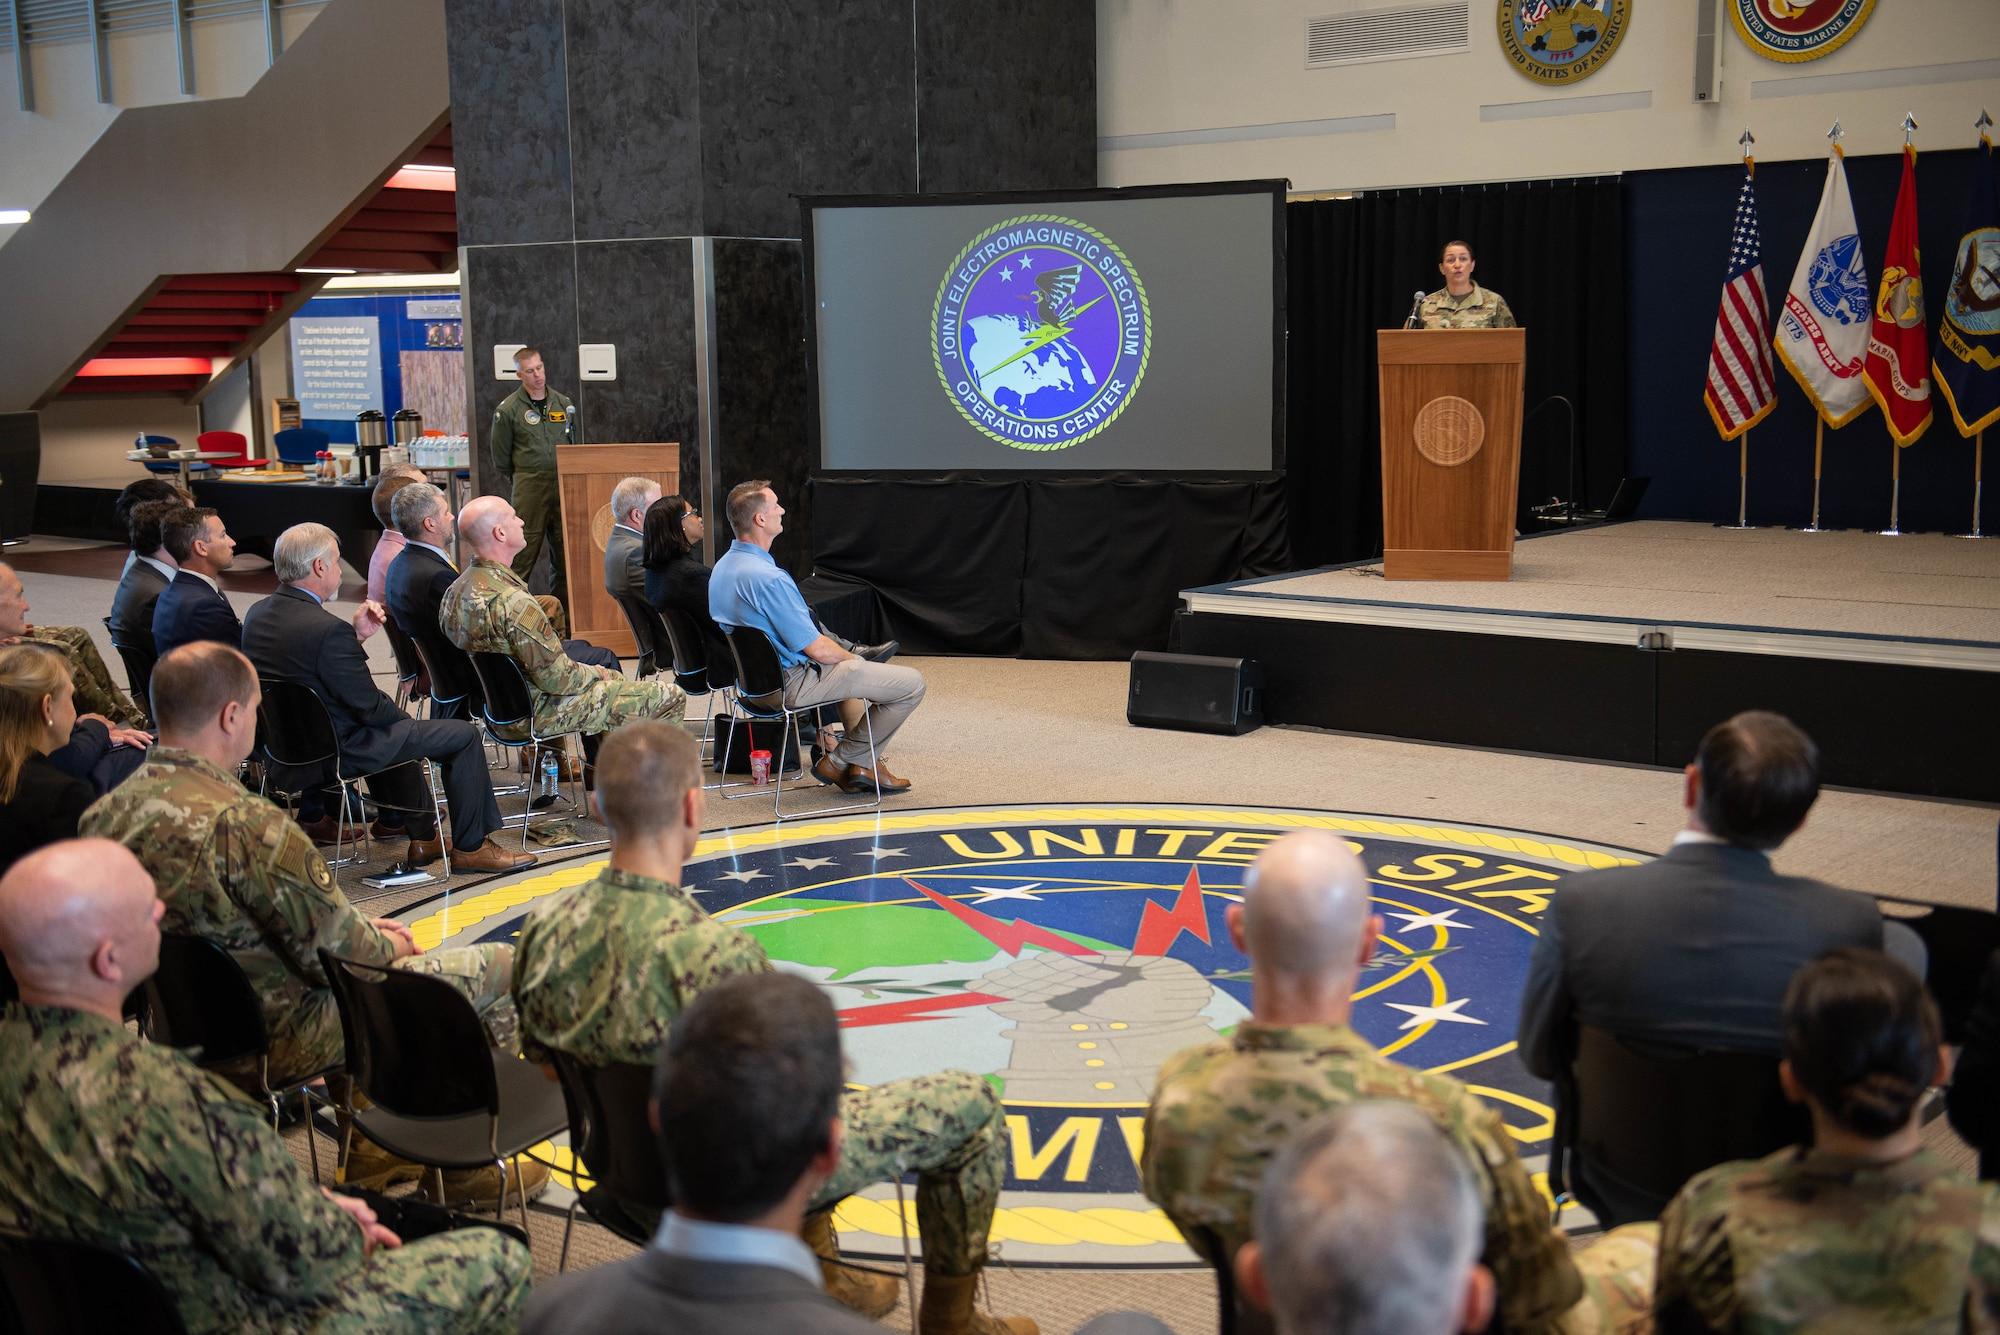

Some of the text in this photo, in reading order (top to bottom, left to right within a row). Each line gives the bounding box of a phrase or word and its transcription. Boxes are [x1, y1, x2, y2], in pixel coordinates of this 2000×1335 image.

[1502, 7, 1625, 79] UNITED STATES OF AMERICA
[1549, 50, 1575, 62] 1775
[1763, 31, 1800, 47] STATES
[1803, 19, 1845, 46] MARINE
[942, 227, 1140, 360] JOINT ELECTROMAGNETIC SPECTRUM
[1791, 300, 1842, 372] STATES ARMY
[956, 378, 1126, 439] OPERATIONS CENTER
[939, 828, 1364, 860] UNITE
